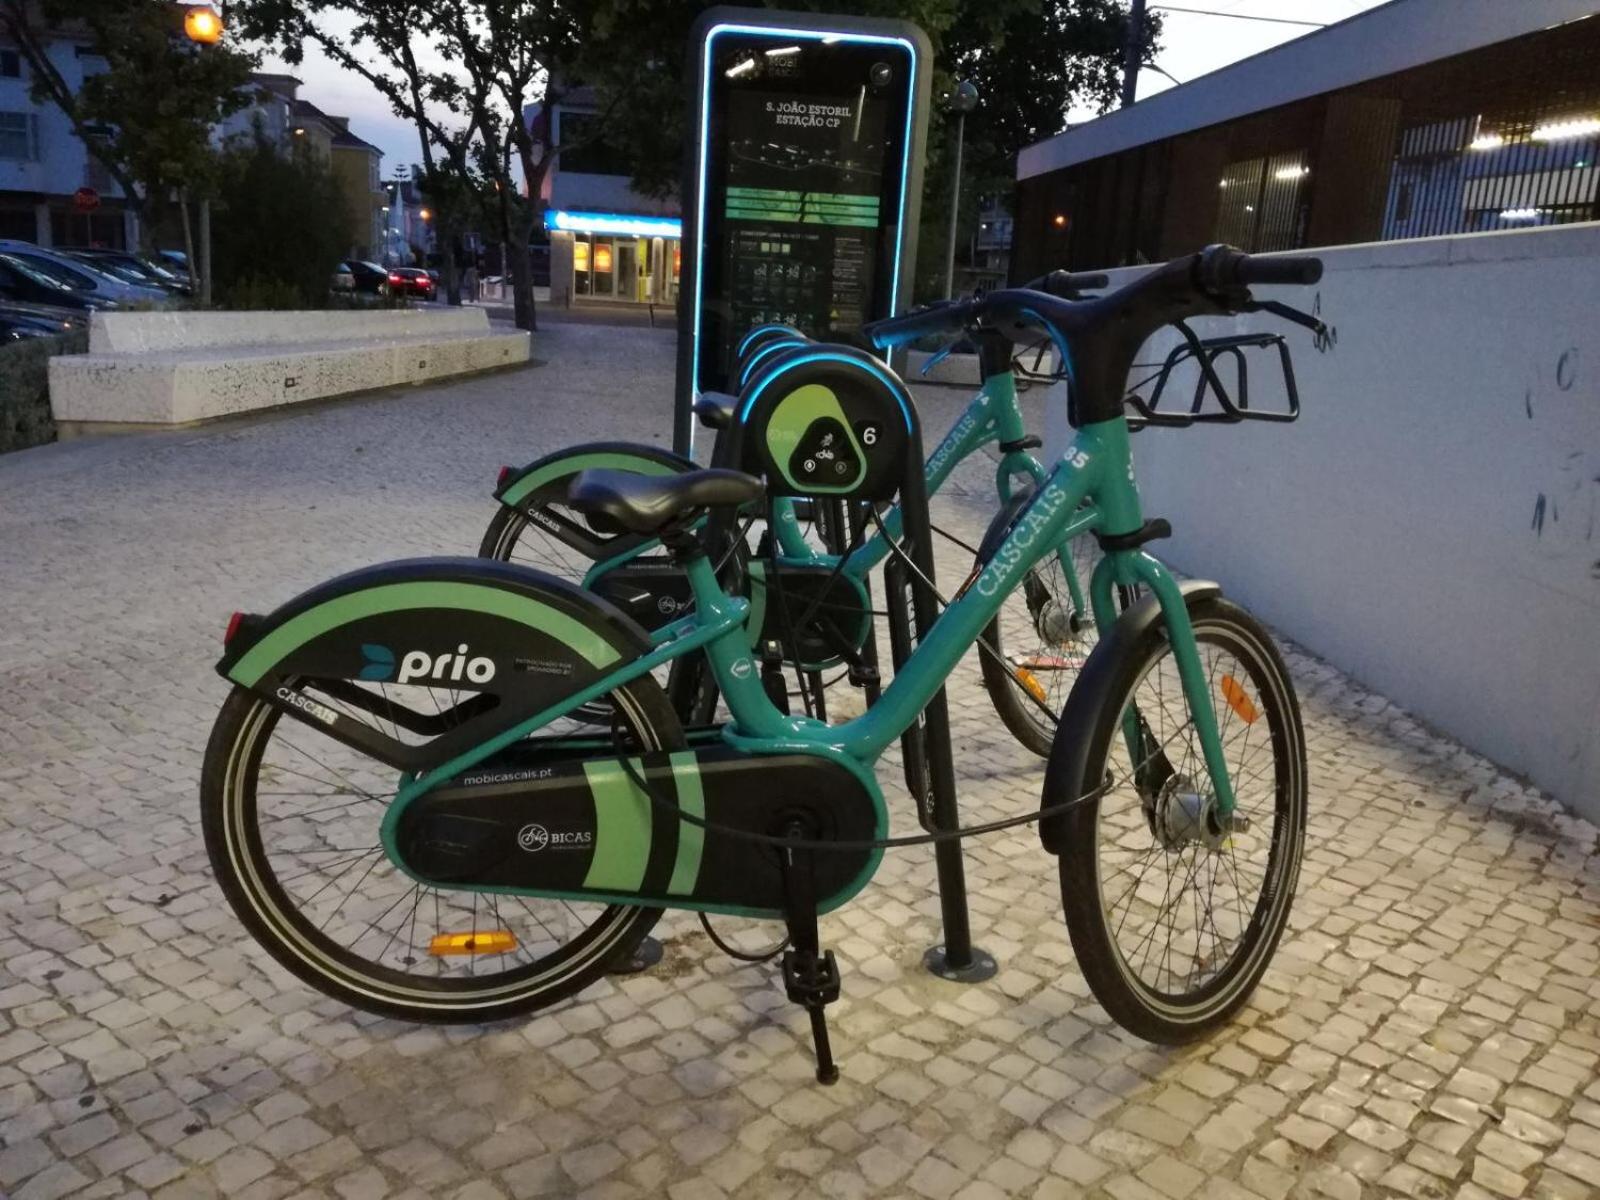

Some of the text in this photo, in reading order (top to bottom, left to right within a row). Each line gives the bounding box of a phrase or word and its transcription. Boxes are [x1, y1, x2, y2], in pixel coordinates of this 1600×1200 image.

[766, 101, 852, 117] S. JOÃO ESTORIL
[776, 114, 840, 128] ESTAÇÃO CP
[863, 427, 877, 445] 6
[1064, 446, 1090, 469] 85
[976, 483, 1067, 596] CASCAIS
[397, 643, 496, 684] prio
[276, 687, 339, 725] CASCAIS
[464, 768, 552, 786] mobicascais.pt
[551, 831, 592, 844] BICAS
